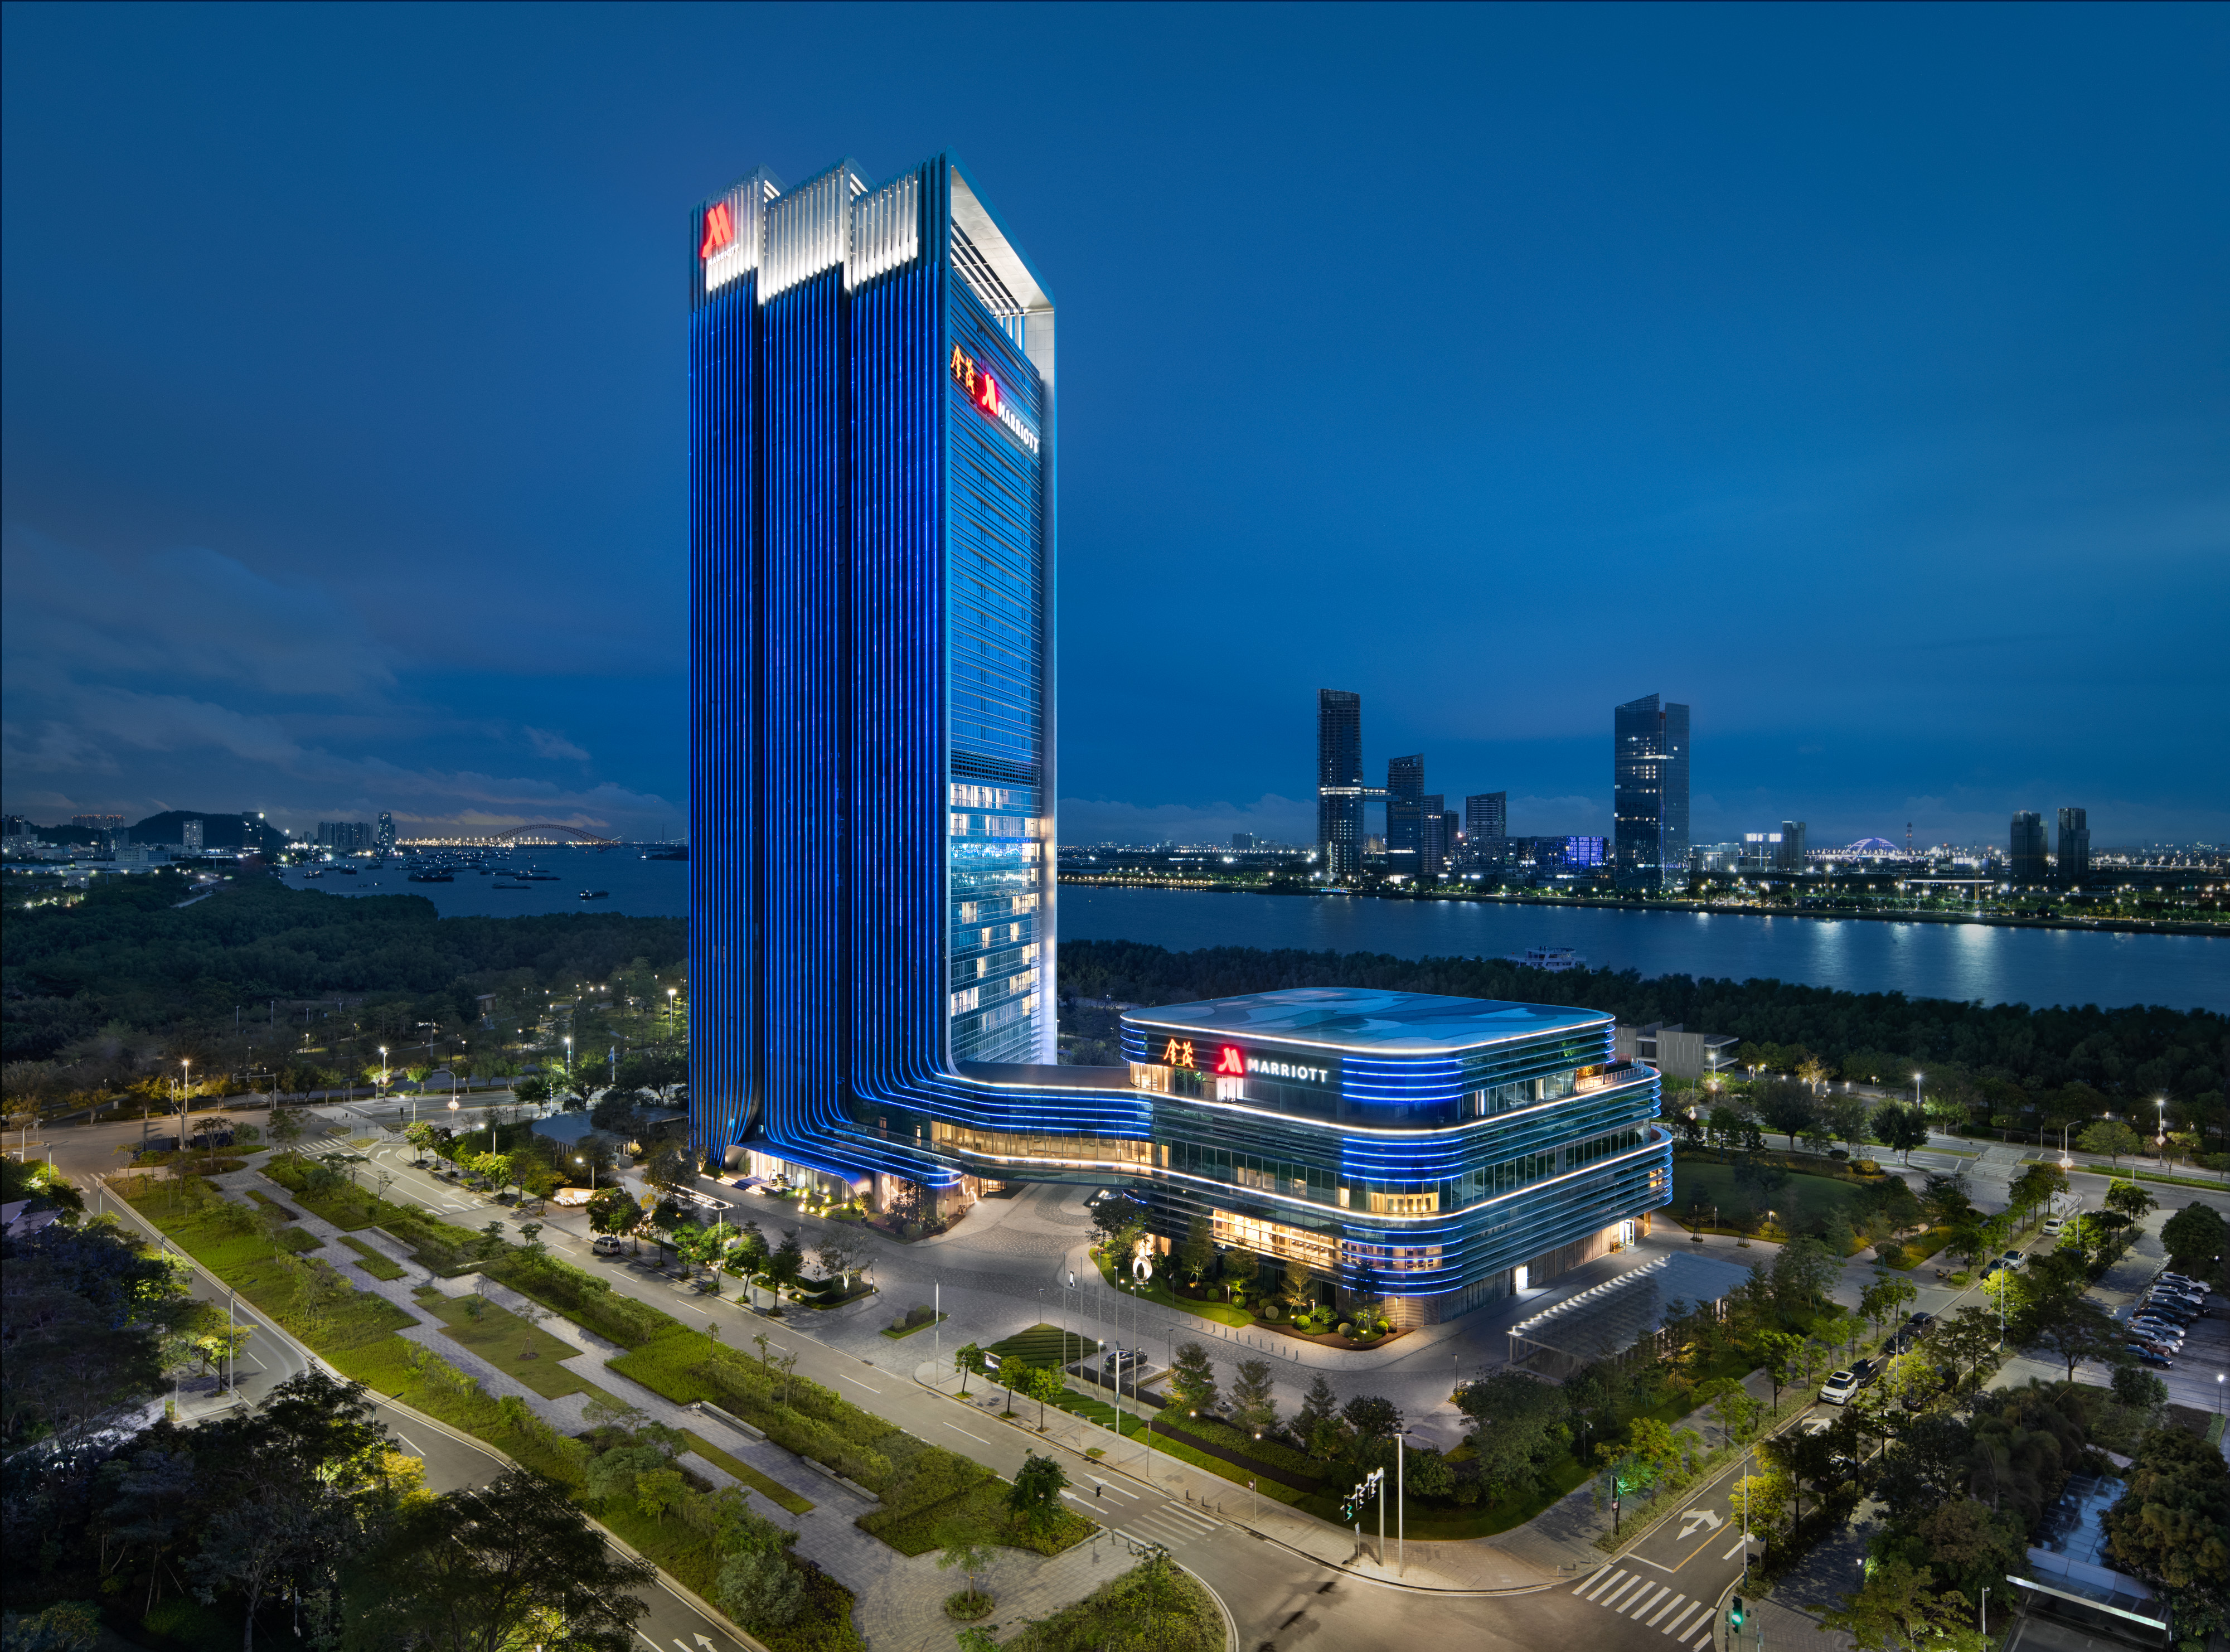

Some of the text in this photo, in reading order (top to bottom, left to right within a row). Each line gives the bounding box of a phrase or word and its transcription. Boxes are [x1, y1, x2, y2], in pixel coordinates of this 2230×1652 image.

[707, 244, 739, 268] MARRIOTT
[951, 346, 975, 395] 金茂
[998, 401, 1039, 454] MARRIOTT
[1164, 1039, 1194, 1068] 金茂
[1248, 1059, 1327, 1082] MARRIOTT
